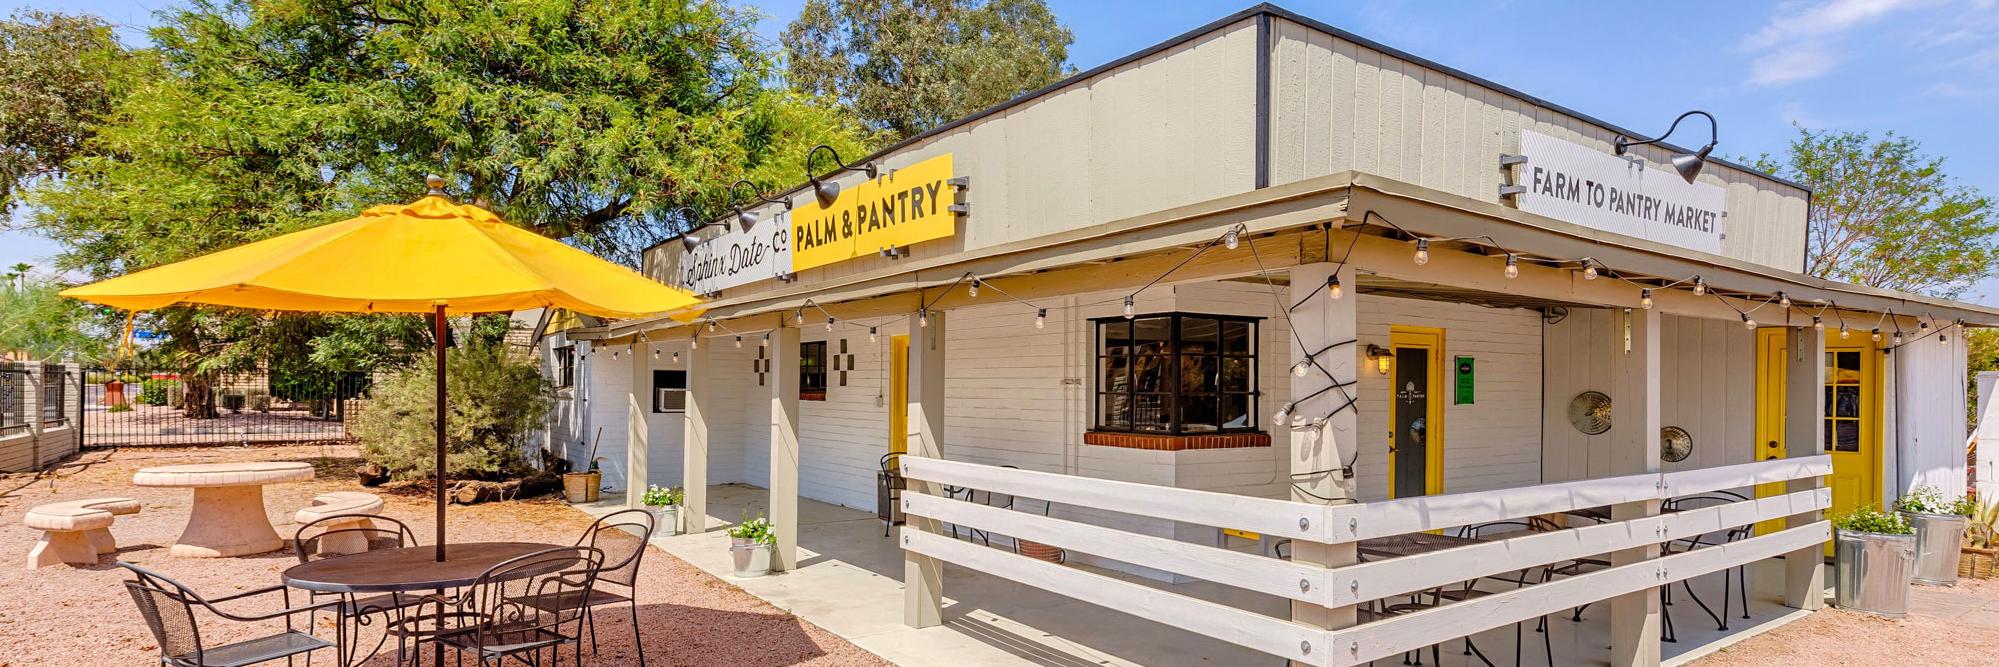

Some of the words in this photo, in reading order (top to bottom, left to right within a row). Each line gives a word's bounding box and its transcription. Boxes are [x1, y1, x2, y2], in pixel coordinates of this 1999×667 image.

[796, 219, 837, 253] PALM
[842, 209, 854, 239] &
[857, 179, 942, 235] PANTRY
[1533, 166, 1580, 203] FARM
[1586, 180, 1605, 209] TO
[1609, 187, 1662, 222] PANTRY
[1664, 203, 1717, 234] MARKET
[686, 253, 726, 290] Sphinx
[728, 235, 770, 276] Date
